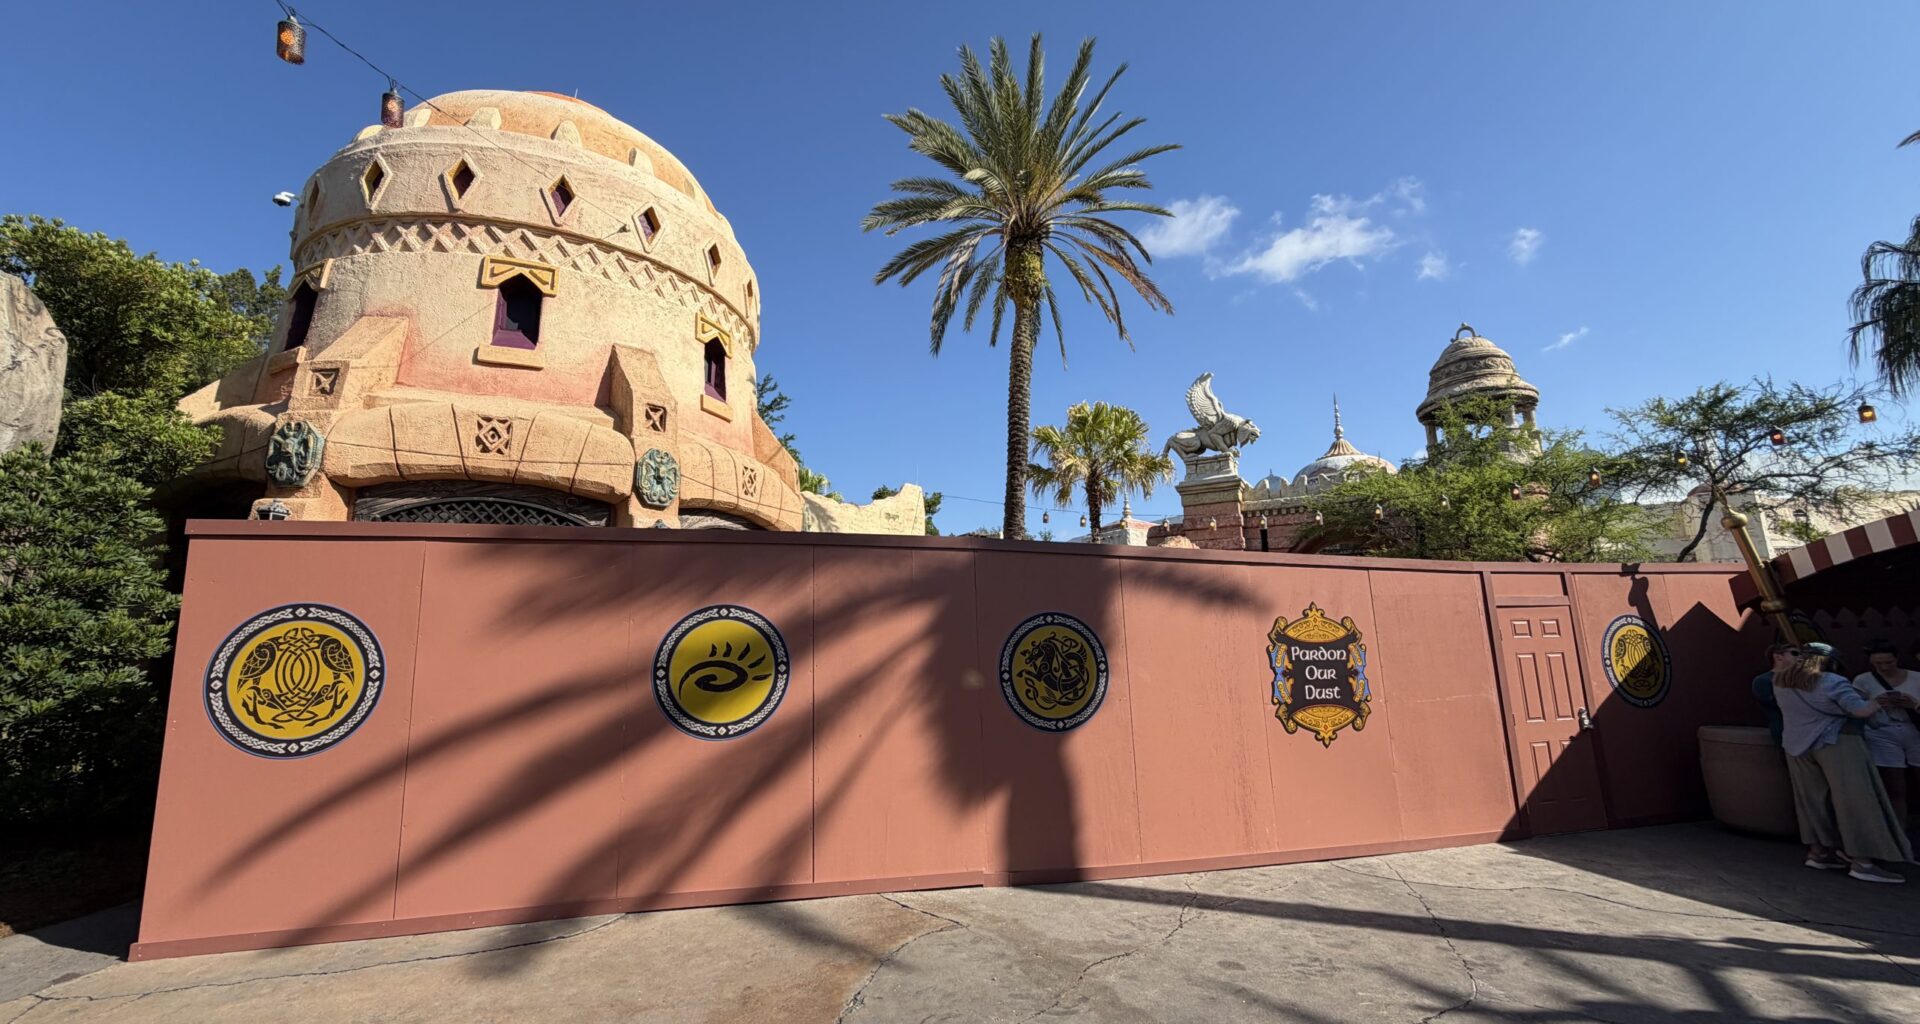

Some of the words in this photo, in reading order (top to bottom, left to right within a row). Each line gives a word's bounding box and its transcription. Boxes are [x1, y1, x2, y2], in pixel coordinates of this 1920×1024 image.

[1291, 646, 1346, 661] Pardon
[1305, 665, 1337, 680] Our
[1305, 685, 1341, 699] Dust
